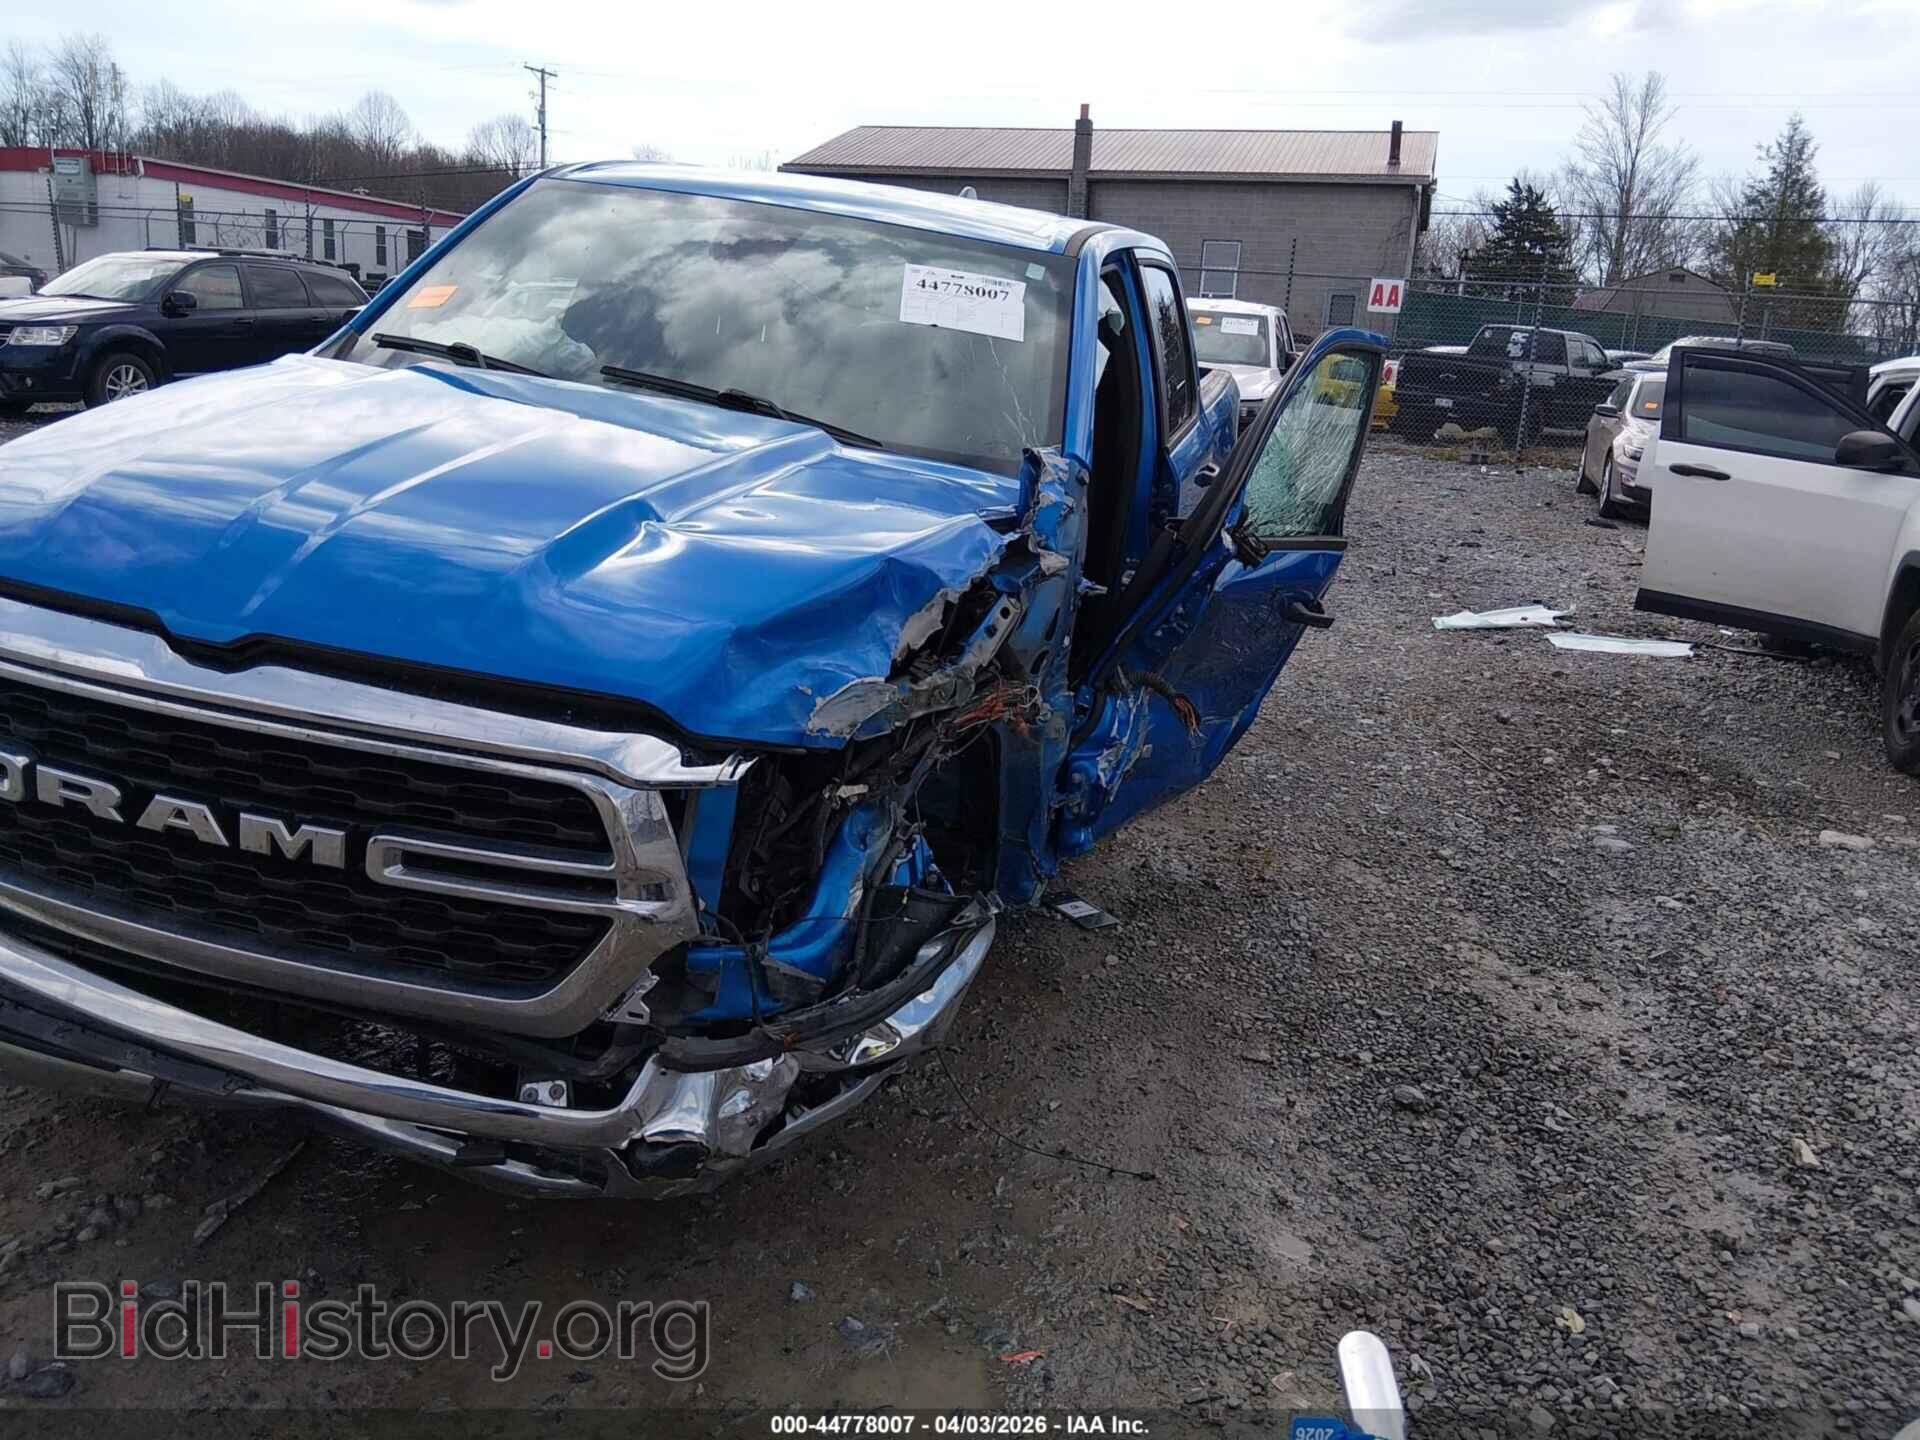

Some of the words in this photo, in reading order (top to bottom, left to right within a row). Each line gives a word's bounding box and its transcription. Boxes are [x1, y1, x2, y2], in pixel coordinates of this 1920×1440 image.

[916, 278, 1009, 301] 44778007
[1371, 284, 1399, 307] AA
[36, 764, 346, 869] RAM
